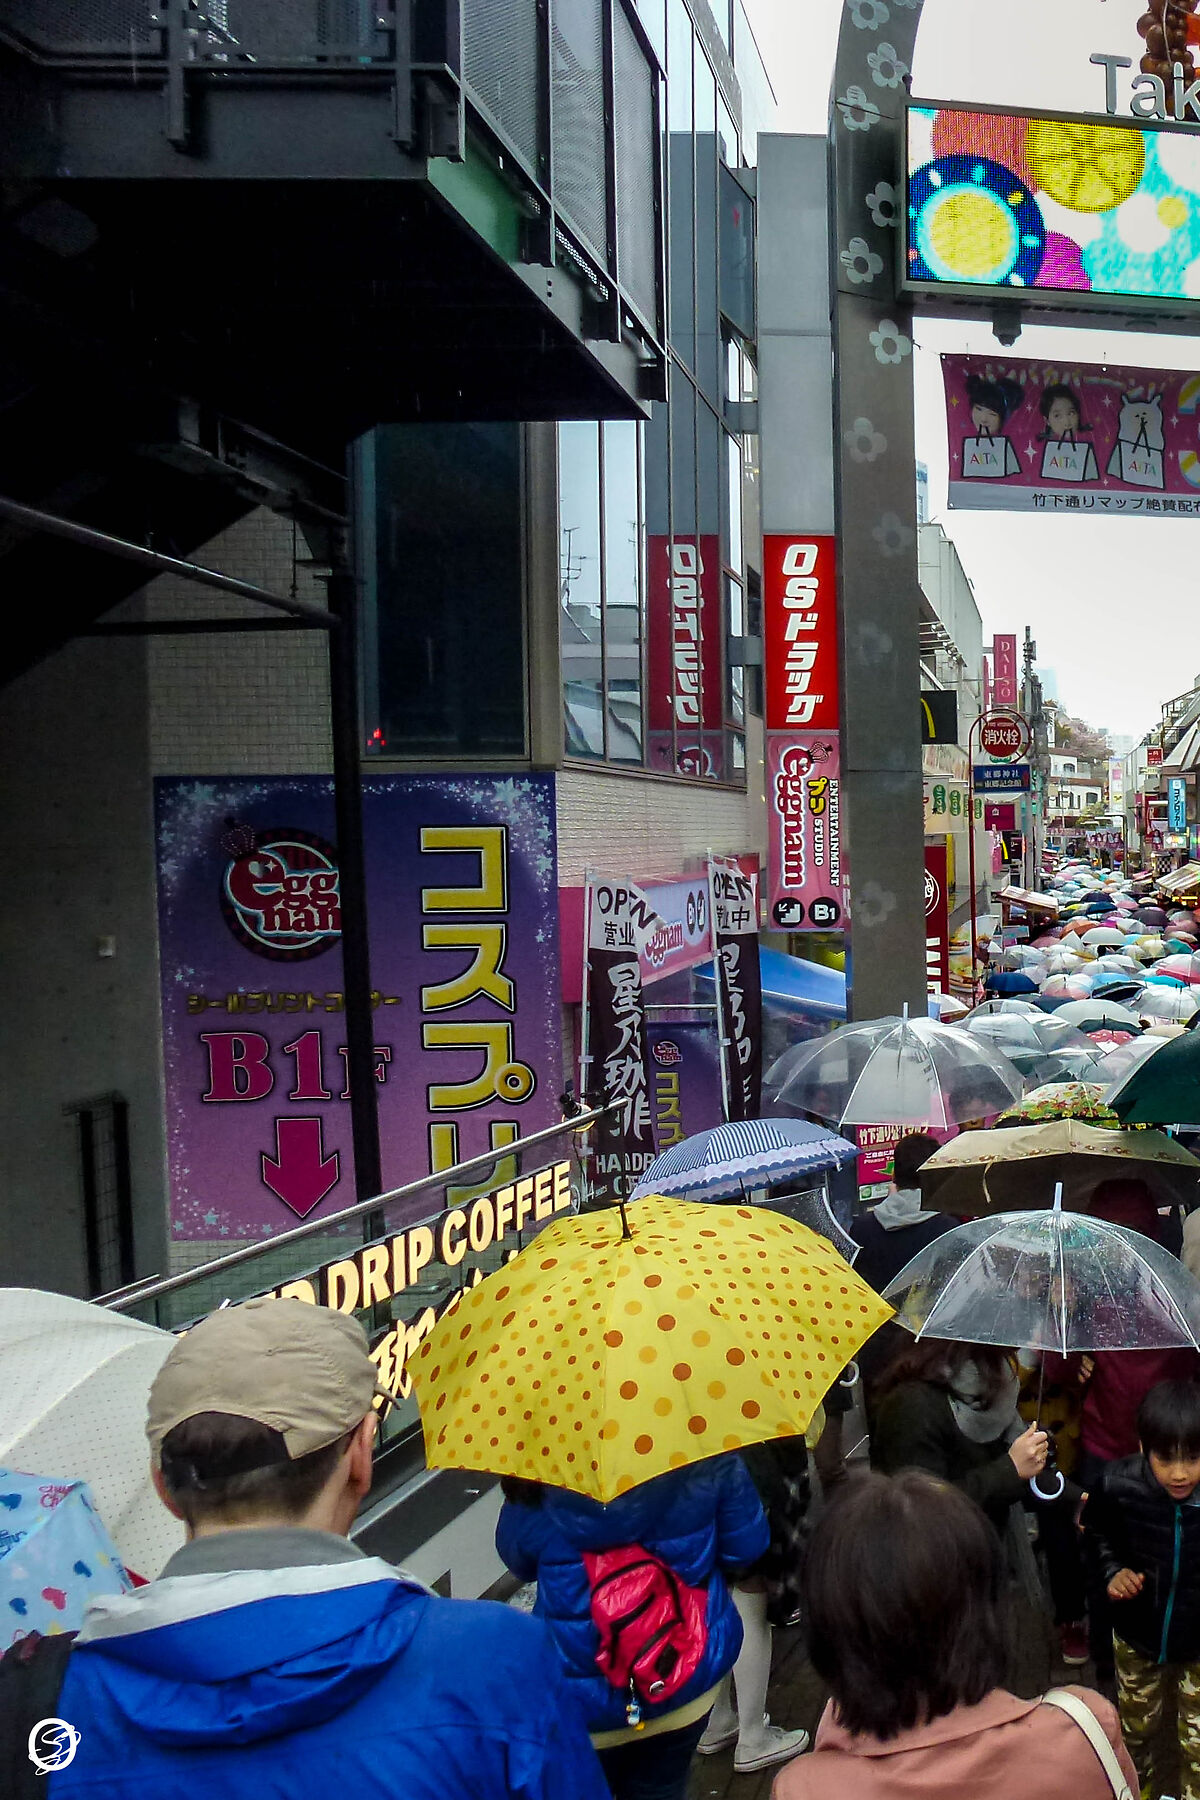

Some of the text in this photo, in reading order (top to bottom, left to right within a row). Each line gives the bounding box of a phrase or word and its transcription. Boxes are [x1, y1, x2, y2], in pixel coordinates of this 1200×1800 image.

[781, 543, 824, 724] OSドラッグ
[984, 729, 1019, 745] 消火栓
[776, 747, 804, 889] eggnam
[807, 776, 828, 816] プリ
[829, 779, 841, 887] ENTERTAINMENT
[814, 818, 825, 867] STUDIO
[814, 904, 837, 921] B1
[328, 1161, 571, 1315] DRIP COFFEE
